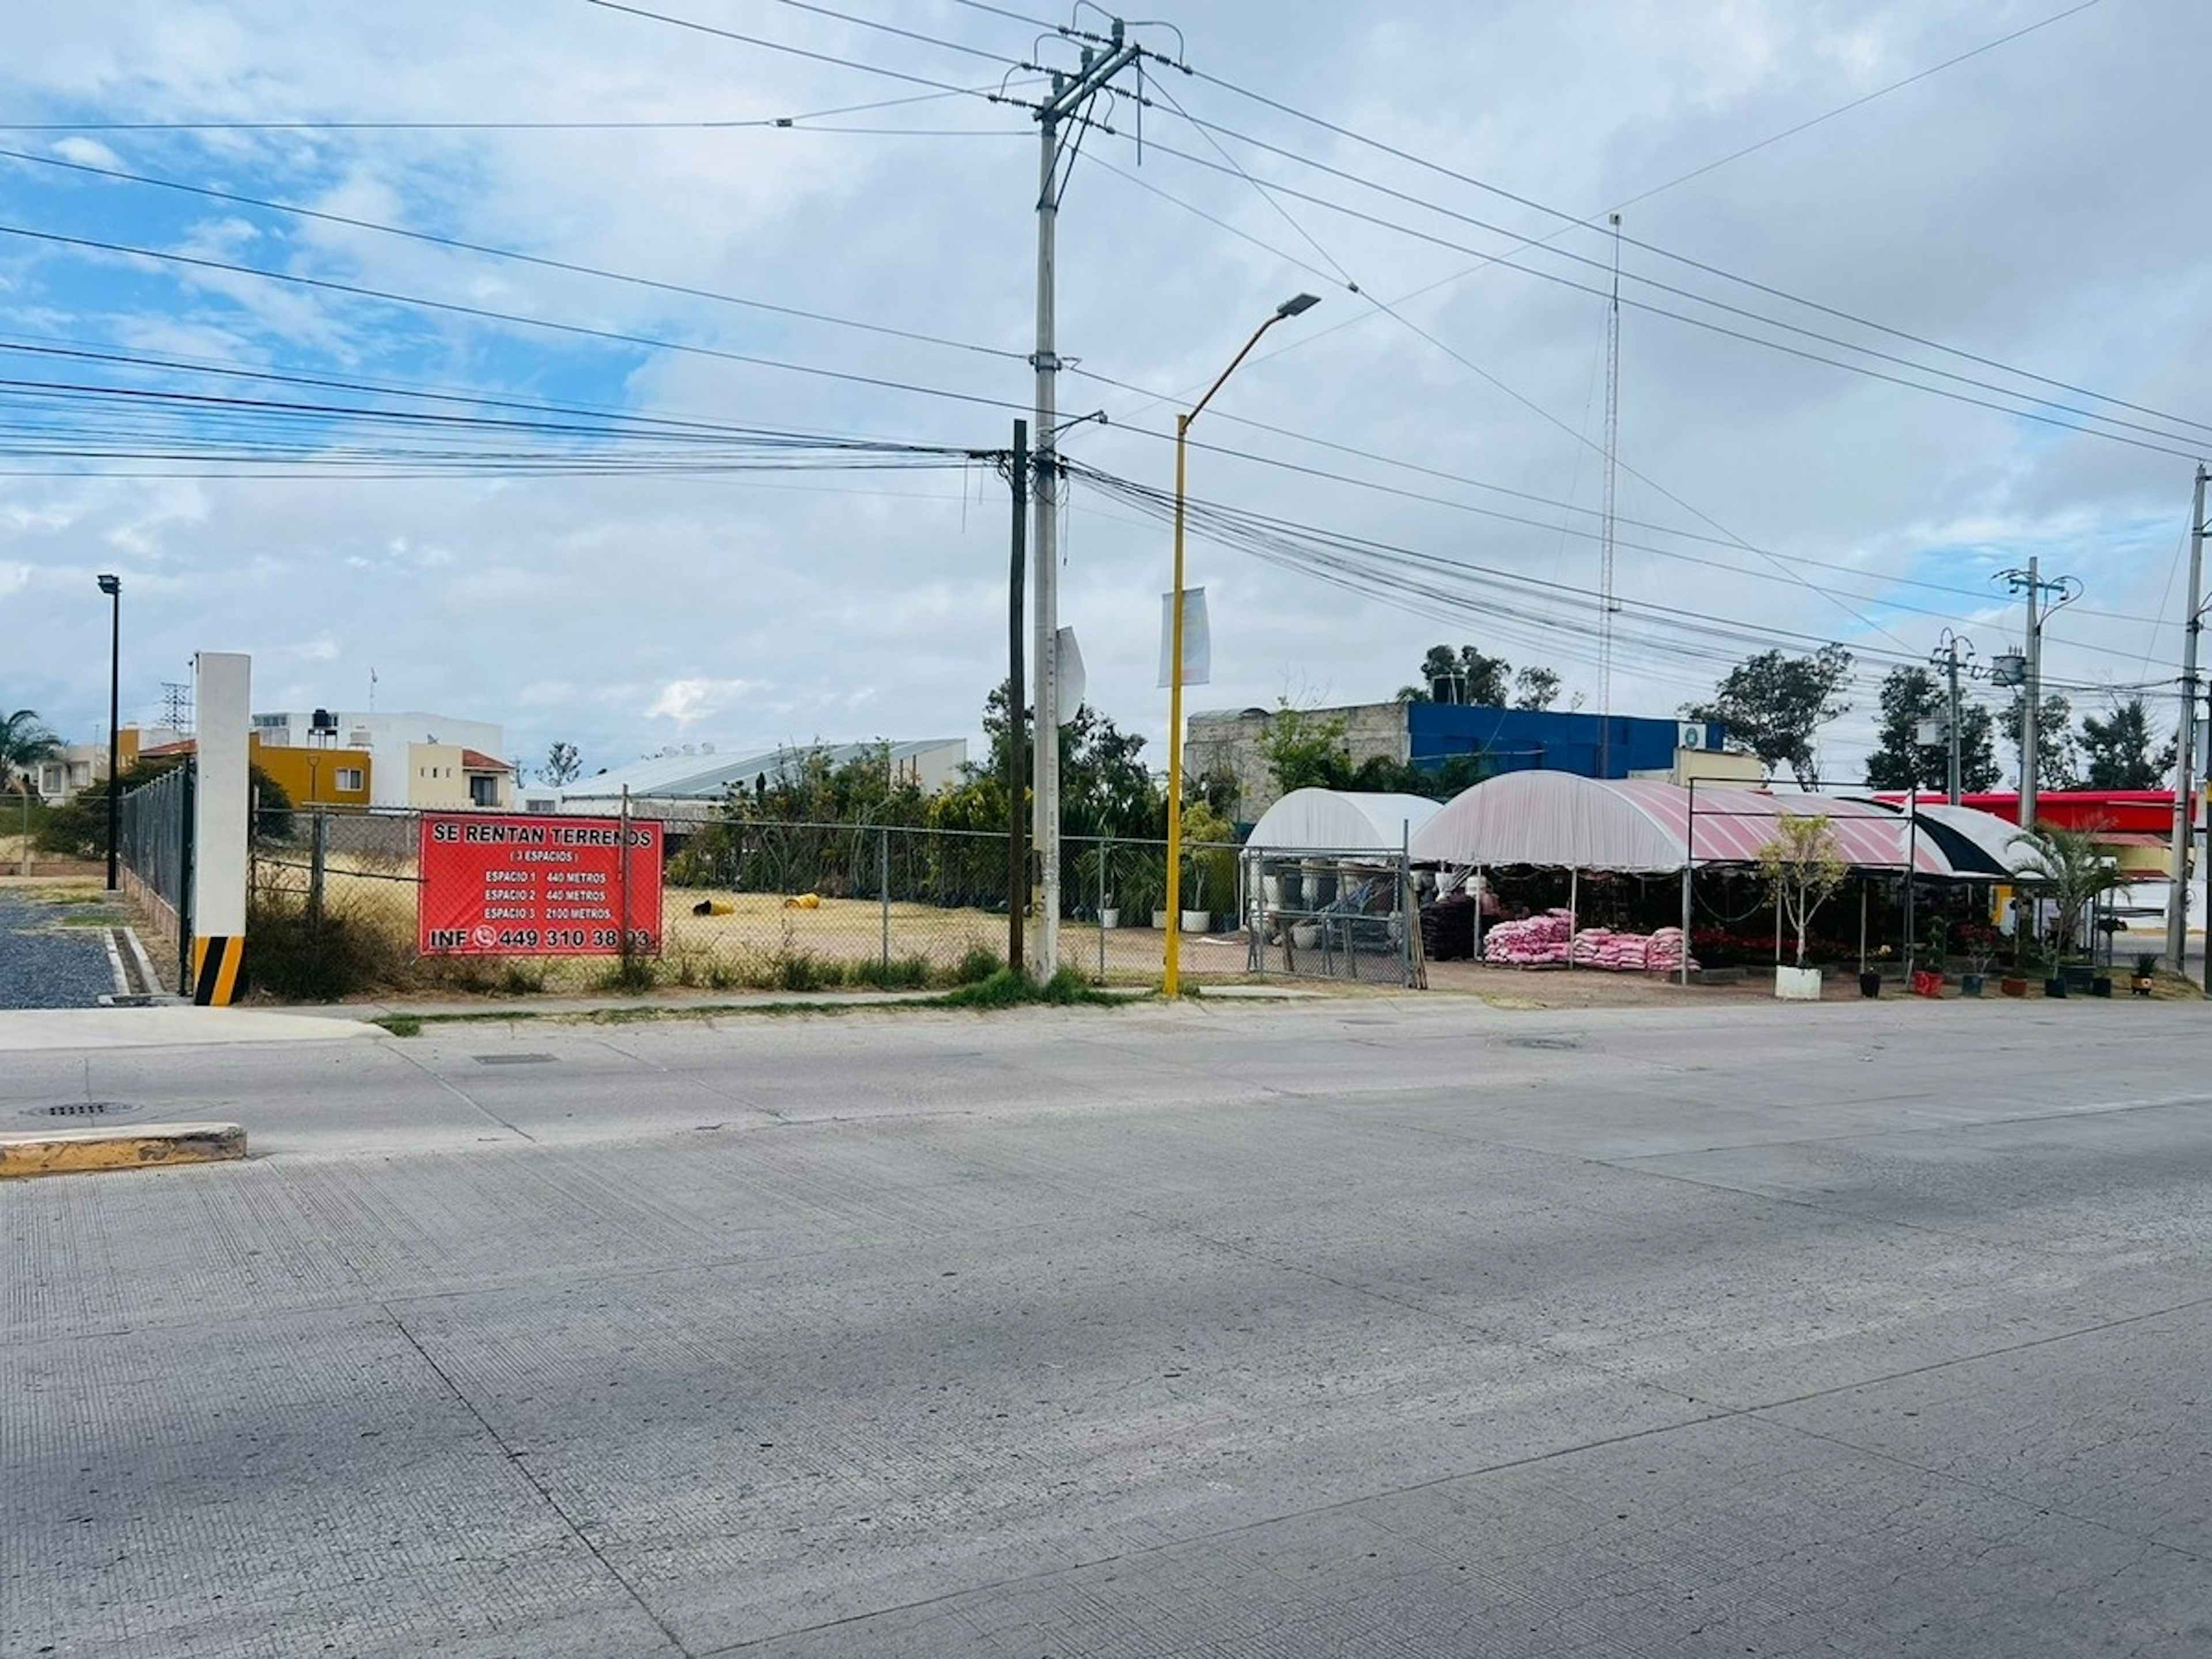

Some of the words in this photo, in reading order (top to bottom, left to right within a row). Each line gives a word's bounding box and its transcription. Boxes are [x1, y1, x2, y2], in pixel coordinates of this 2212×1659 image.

[434, 824, 458, 841] SE
[466, 825, 544, 843] RENTAN
[551, 828, 651, 846] TERRENOS
[524, 850, 573, 862] ESPACIOS
[485, 870, 529, 883] ESPACIO
[529, 872, 536, 882] 1
[547, 872, 565, 883] 440
[567, 873, 607, 885] METROS
[484, 889, 528, 901] ESPACIO
[528, 890, 536, 901] 2
[547, 889, 565, 901] 440
[566, 891, 606, 902] METROS
[484, 907, 527, 920] ESPACIO
[546, 908, 570, 920] 2100
[571, 908, 612, 920] METROS
[431, 930, 467, 946] INF
[499, 930, 538, 946] 449
[547, 930, 584, 946] 310
[593, 930, 617, 946] 38
